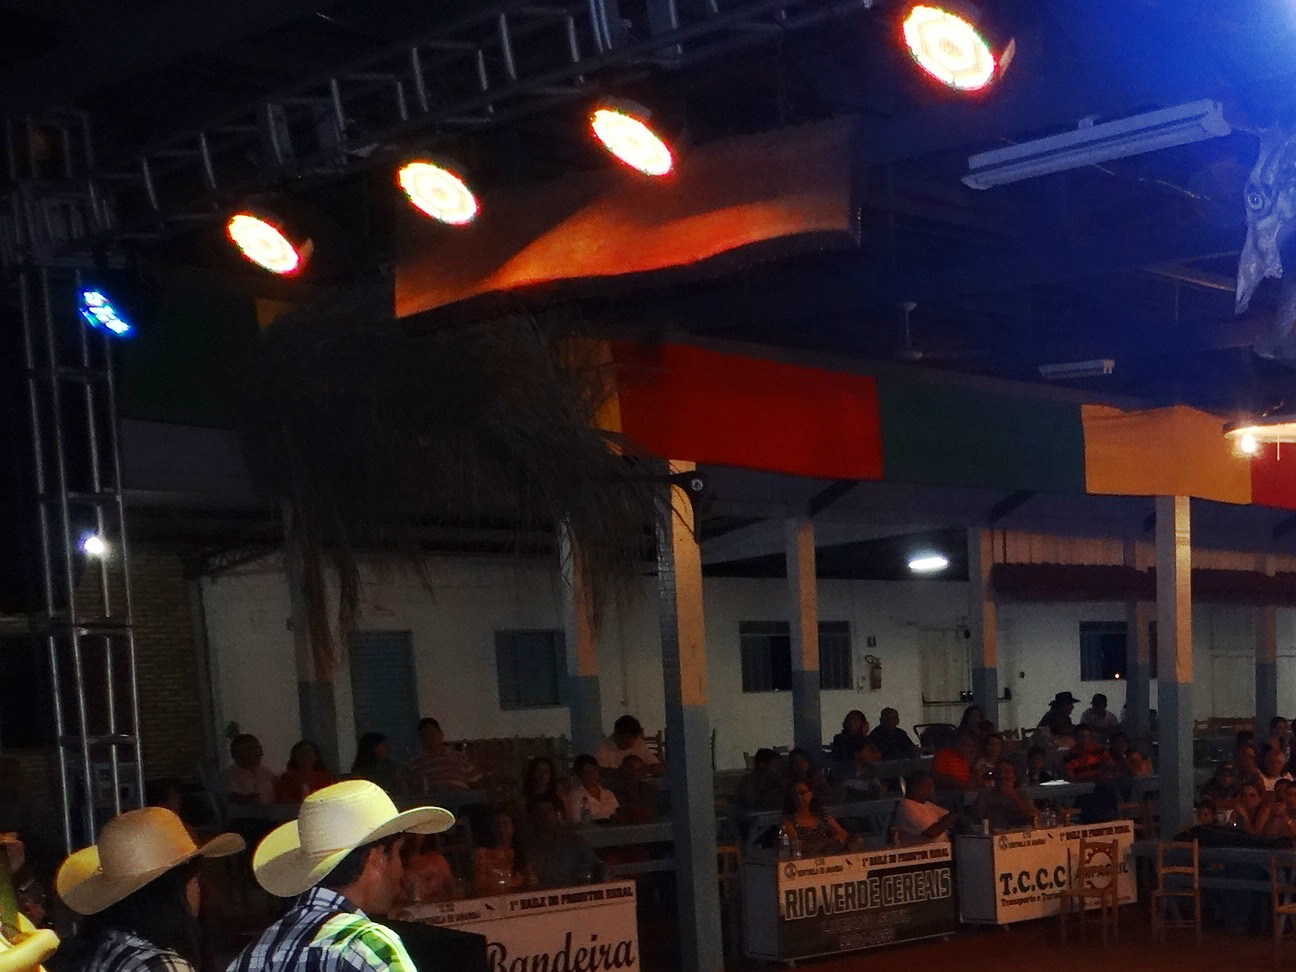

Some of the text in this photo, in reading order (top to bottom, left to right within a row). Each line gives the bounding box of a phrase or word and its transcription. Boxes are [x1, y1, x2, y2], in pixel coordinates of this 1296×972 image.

[561, 890, 604, 905] PRODUTOR
[605, 887, 633, 899] RURAL
[784, 867, 951, 921] RIO VERDE CEREAIS
[1001, 896, 1036, 906] Transporte
